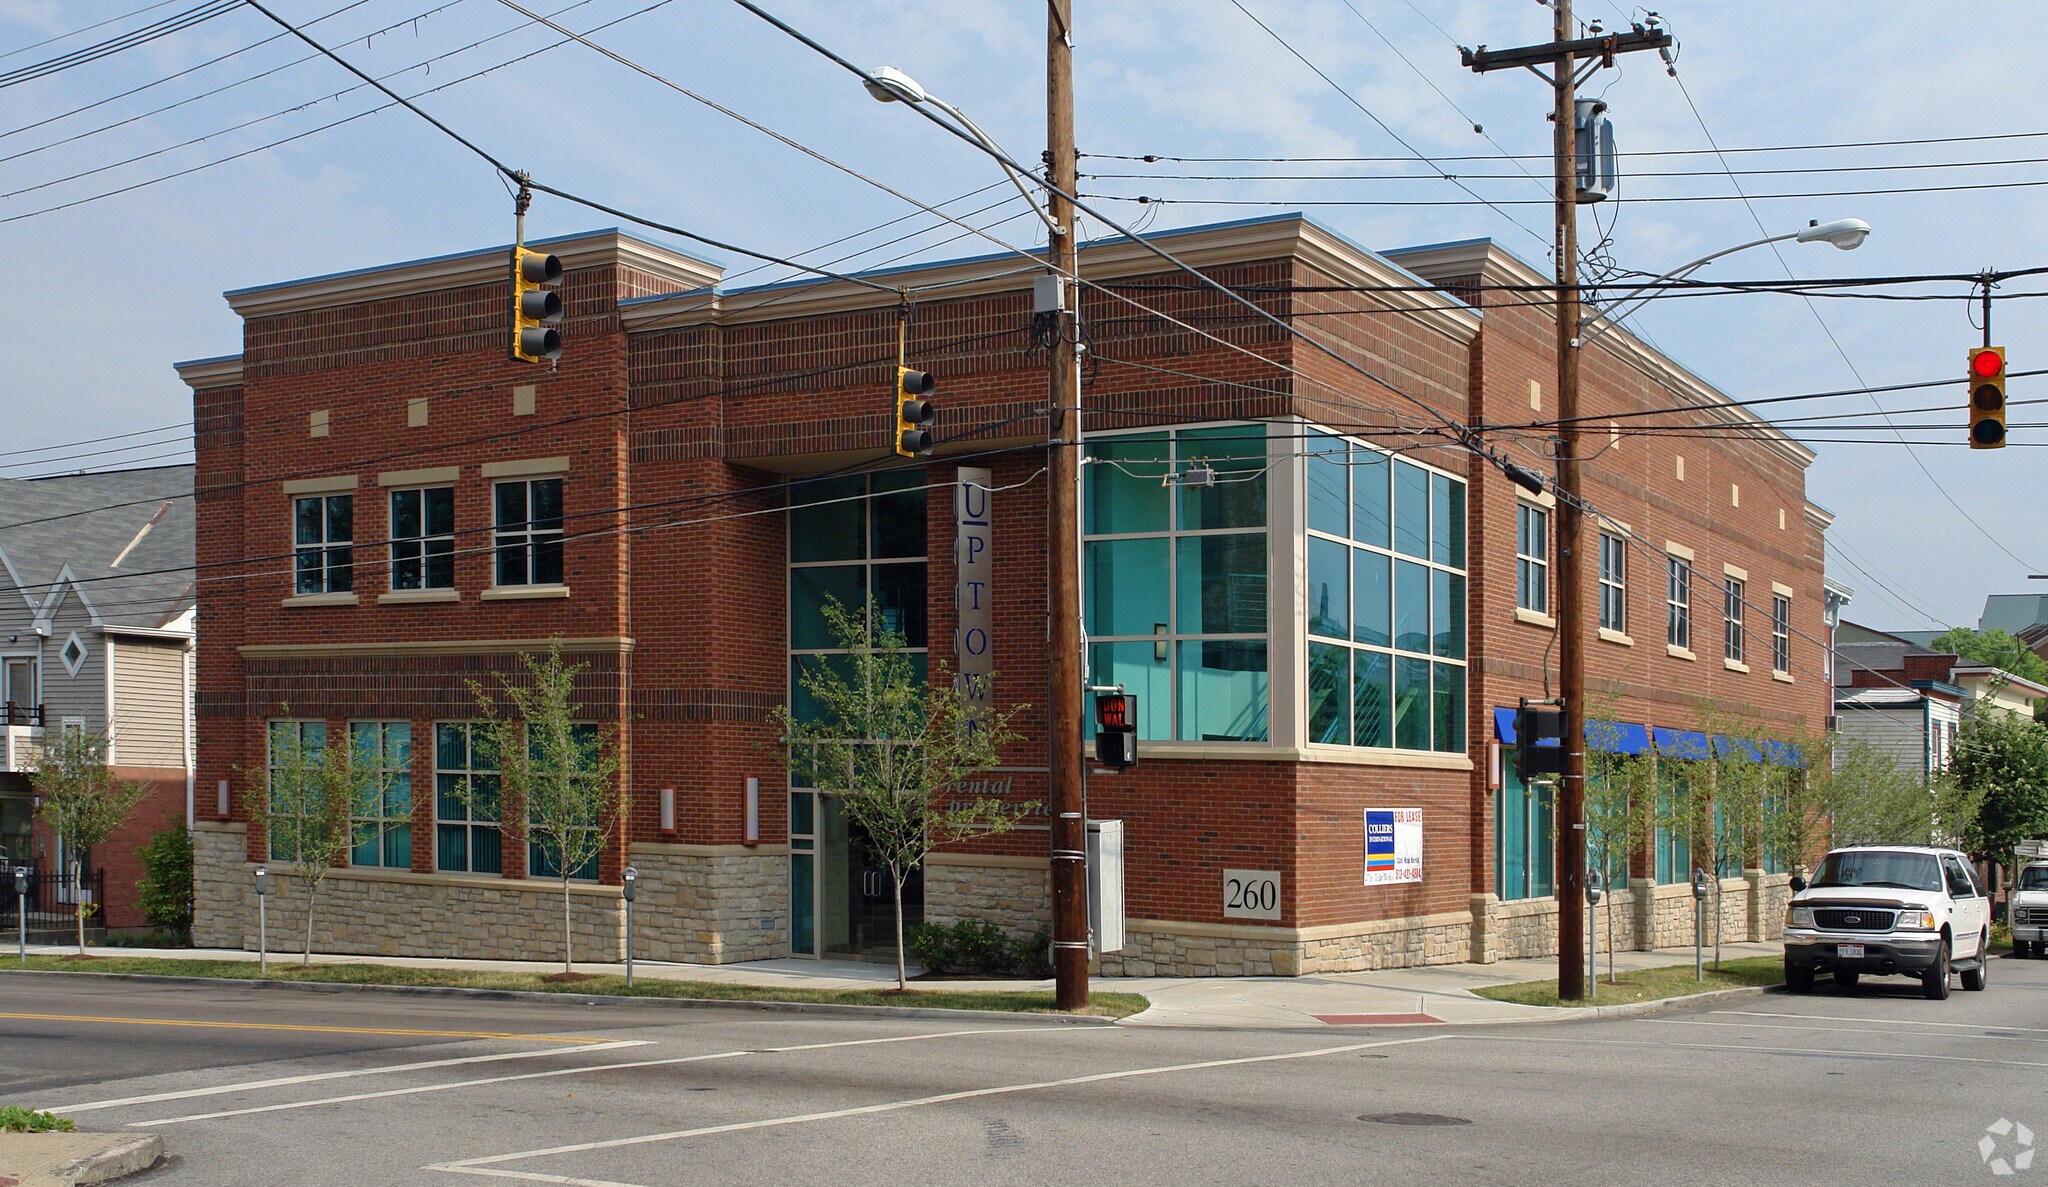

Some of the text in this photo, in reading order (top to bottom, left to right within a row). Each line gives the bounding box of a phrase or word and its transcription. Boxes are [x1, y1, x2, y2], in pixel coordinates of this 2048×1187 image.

[1103, 712, 1126, 726] WAL
[946, 776, 1014, 794] rental
[1395, 811, 1421, 822] FOR LEASE
[1227, 879, 1276, 911] 260
